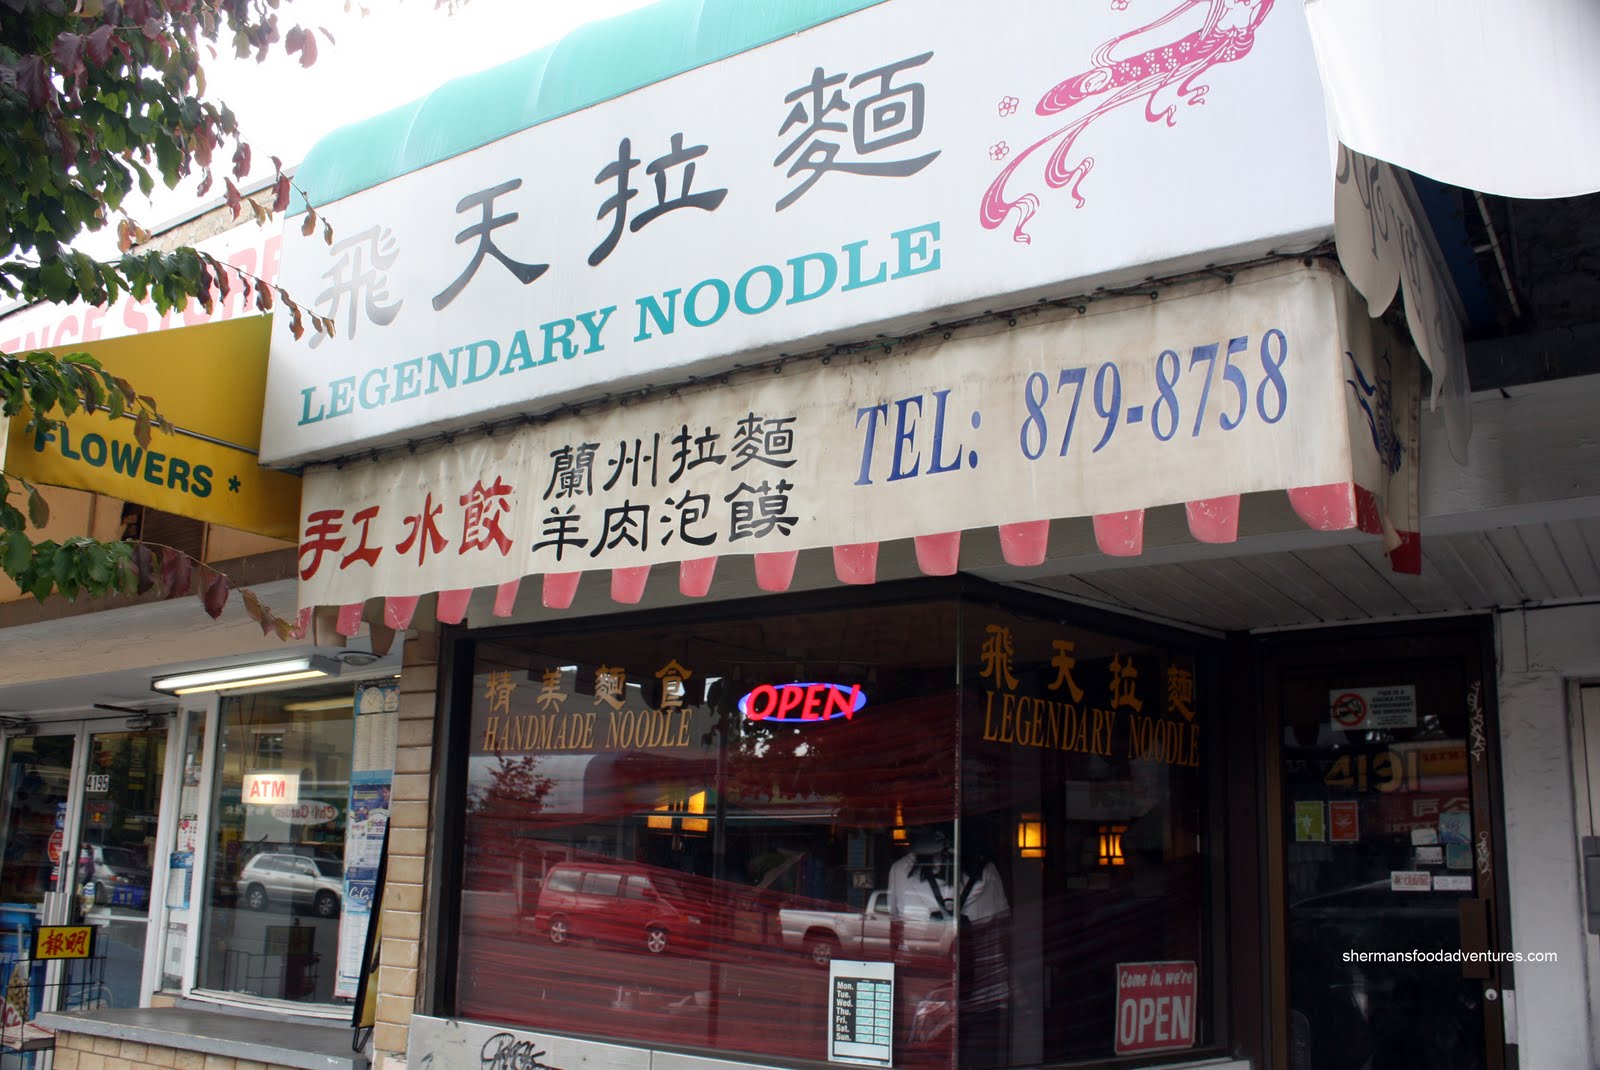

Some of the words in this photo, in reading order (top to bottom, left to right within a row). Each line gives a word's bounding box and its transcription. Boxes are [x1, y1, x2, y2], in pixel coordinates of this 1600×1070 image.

[307, 50, 942, 349] 飛天拉麵
[298, 306, 617, 427] LEGENDARY
[632, 220, 941, 343] NOODLE
[853, 388, 982, 486] TEL:
[1019, 327, 1289, 461] 879-8758
[33, 422, 213, 498] FLOWERS
[542, 412, 798, 500] 蘭州拉麵
[299, 473, 514, 582] 手工水餃
[531, 480, 801, 562] 羊肉泡饃
[979, 624, 1197, 722] 飛天拉麵
[745, 684, 862, 721] OPEN
[482, 712, 597, 752] HANDMADE
[605, 708, 693, 749] NOODLE
[982, 690, 1117, 757] LEGENDARY
[1127, 714, 1200, 769] NOODLE
[86, 775, 110, 791] 4195
[249, 780, 287, 798] ATM
[1323, 750, 1420, 794] 4191
[836, 981, 854, 990] Mon.
[836, 990, 851, 999] Tue.
[1120, 970, 1148, 988] Come
[1165, 968, 1193, 986] we're
[835, 998, 853, 1007] Wed.
[835, 1007, 851, 1016] Thu.
[835, 1015, 848, 1024] Fri.
[1119, 995, 1191, 1046] OPEN
[835, 1024, 850, 1033] Sat.
[835, 1033, 852, 1042] Sun.
